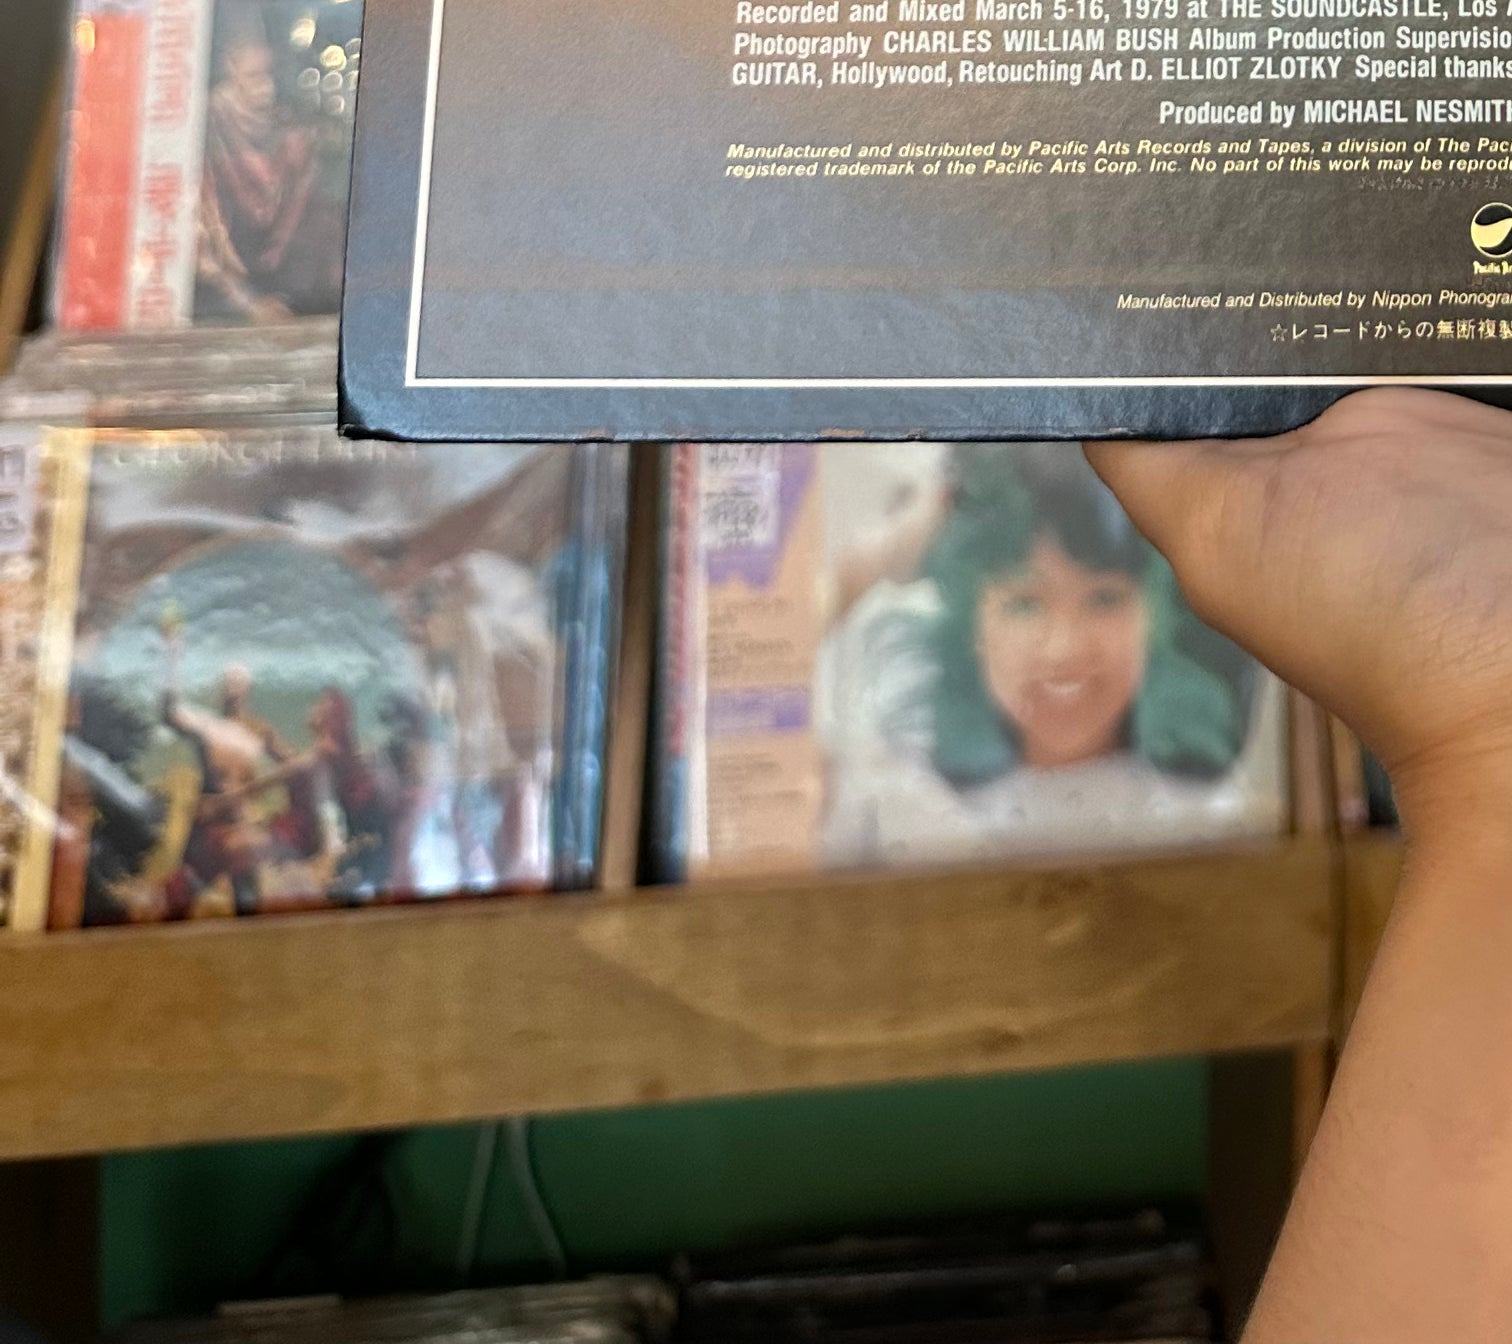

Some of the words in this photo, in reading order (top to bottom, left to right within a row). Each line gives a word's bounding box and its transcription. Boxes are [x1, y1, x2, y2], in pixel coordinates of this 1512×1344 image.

[1159, 101, 1263, 124] Produced
[1269, 101, 1296, 128] by
[1303, 100, 1409, 123] MICHAEL
[726, 143, 851, 159] Manufactured
[857, 142, 892, 157] and
[898, 141, 996, 157] distributed
[1000, 141, 1026, 159] by
[1028, 140, 1088, 156] Pacific
[1094, 140, 1130, 155] Arts
[1136, 139, 1211, 155] Records
[1217, 139, 1250, 154] and
[1256, 139, 1315, 157] Tapes,
[1320, 142, 1331, 154] a
[1337, 139, 1406, 154] division
[1412, 138, 1429, 154] of
[1438, 138, 1470, 153] The
[1117, 292, 1221, 309] Manufactured
[1225, 291, 1254, 308] and
[1259, 290, 1342, 307] Distributed
[1347, 290, 1366, 309] by
[1372, 290, 1432, 309] Nippon
